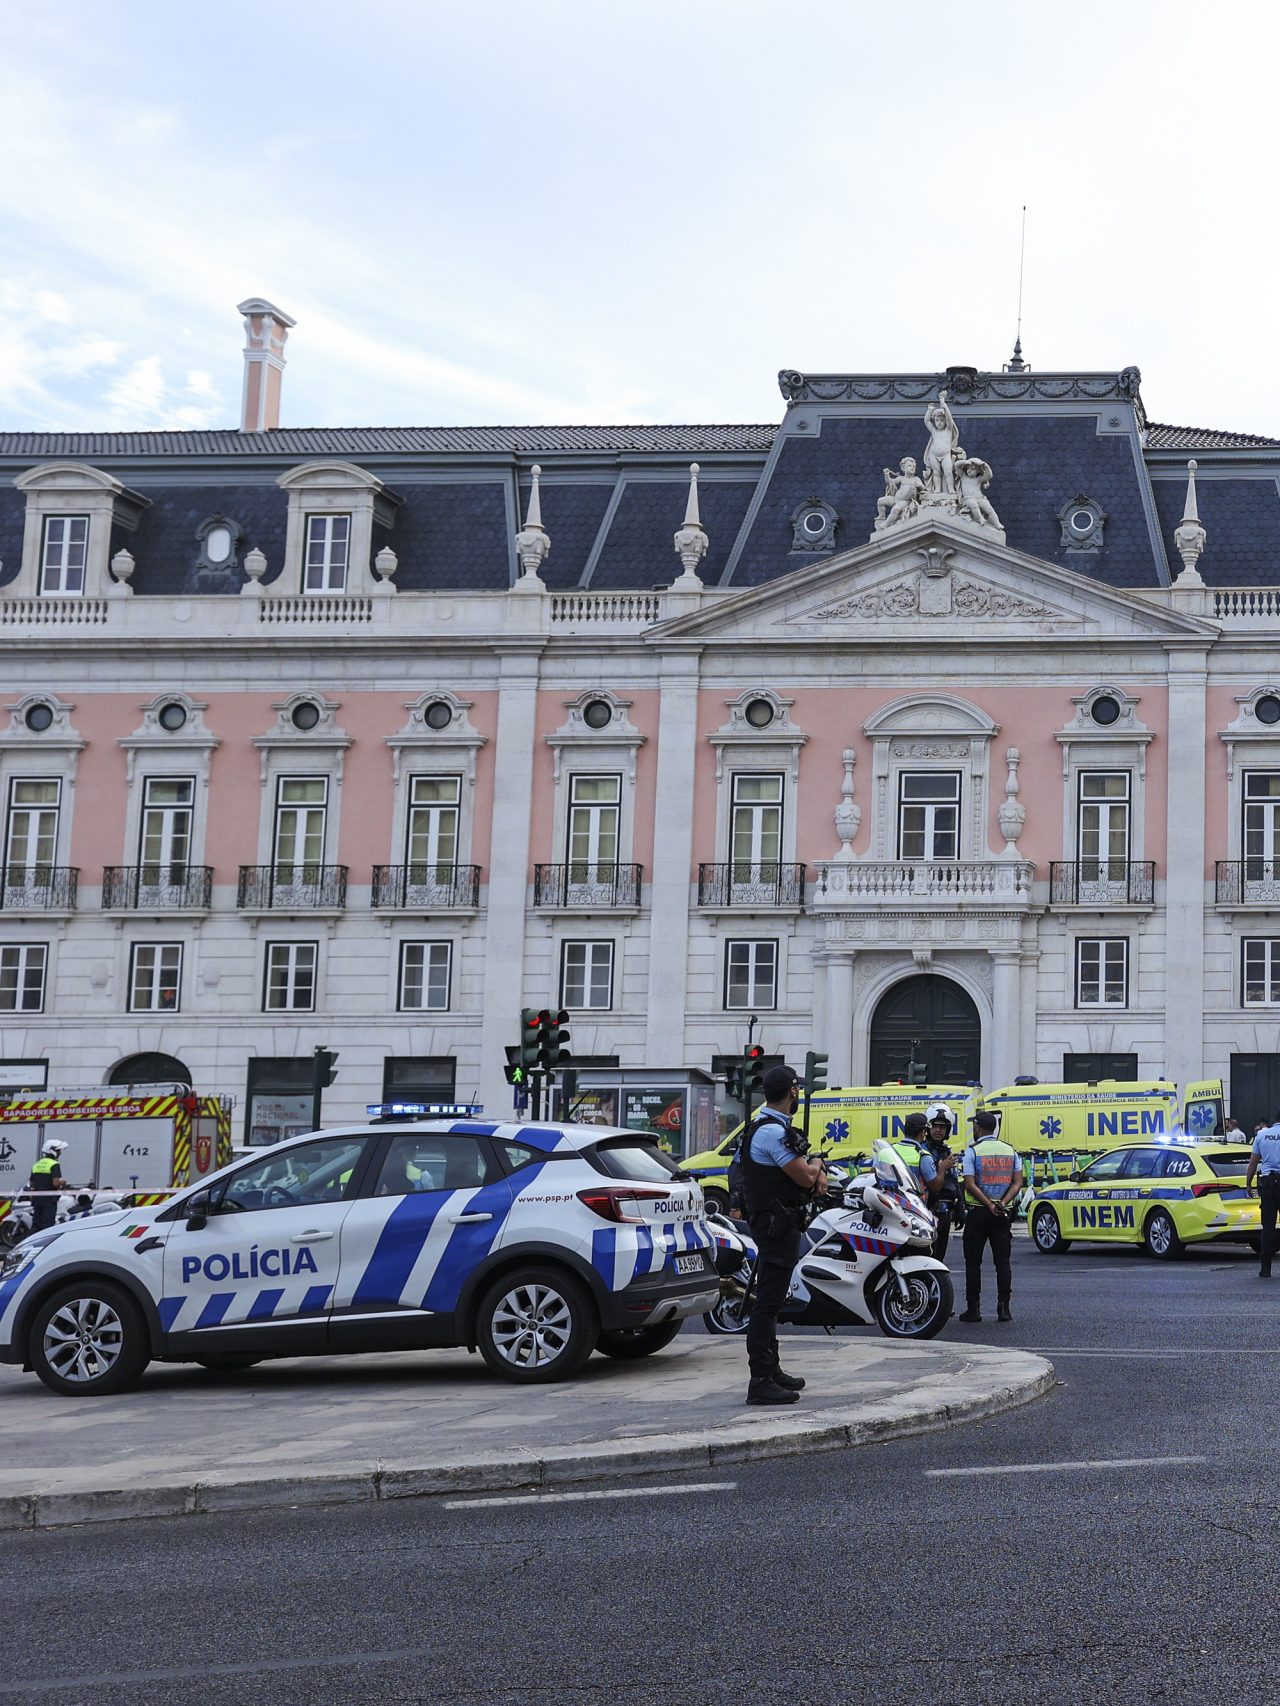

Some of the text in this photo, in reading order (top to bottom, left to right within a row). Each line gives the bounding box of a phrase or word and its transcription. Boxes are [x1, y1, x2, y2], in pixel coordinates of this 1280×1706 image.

[3, 1109, 54, 1117] SAPADORES
[1088, 1110, 1164, 1136] INEM
[130, 1148, 148, 1156] 112
[1172, 1161, 1190, 1173] 112
[518, 1194, 573, 1203] www.psp.pt
[654, 1199, 684, 1213] POLÍCIA
[1073, 1206, 1135, 1228] INEM
[182, 1244, 318, 1283] POLÍCIA
